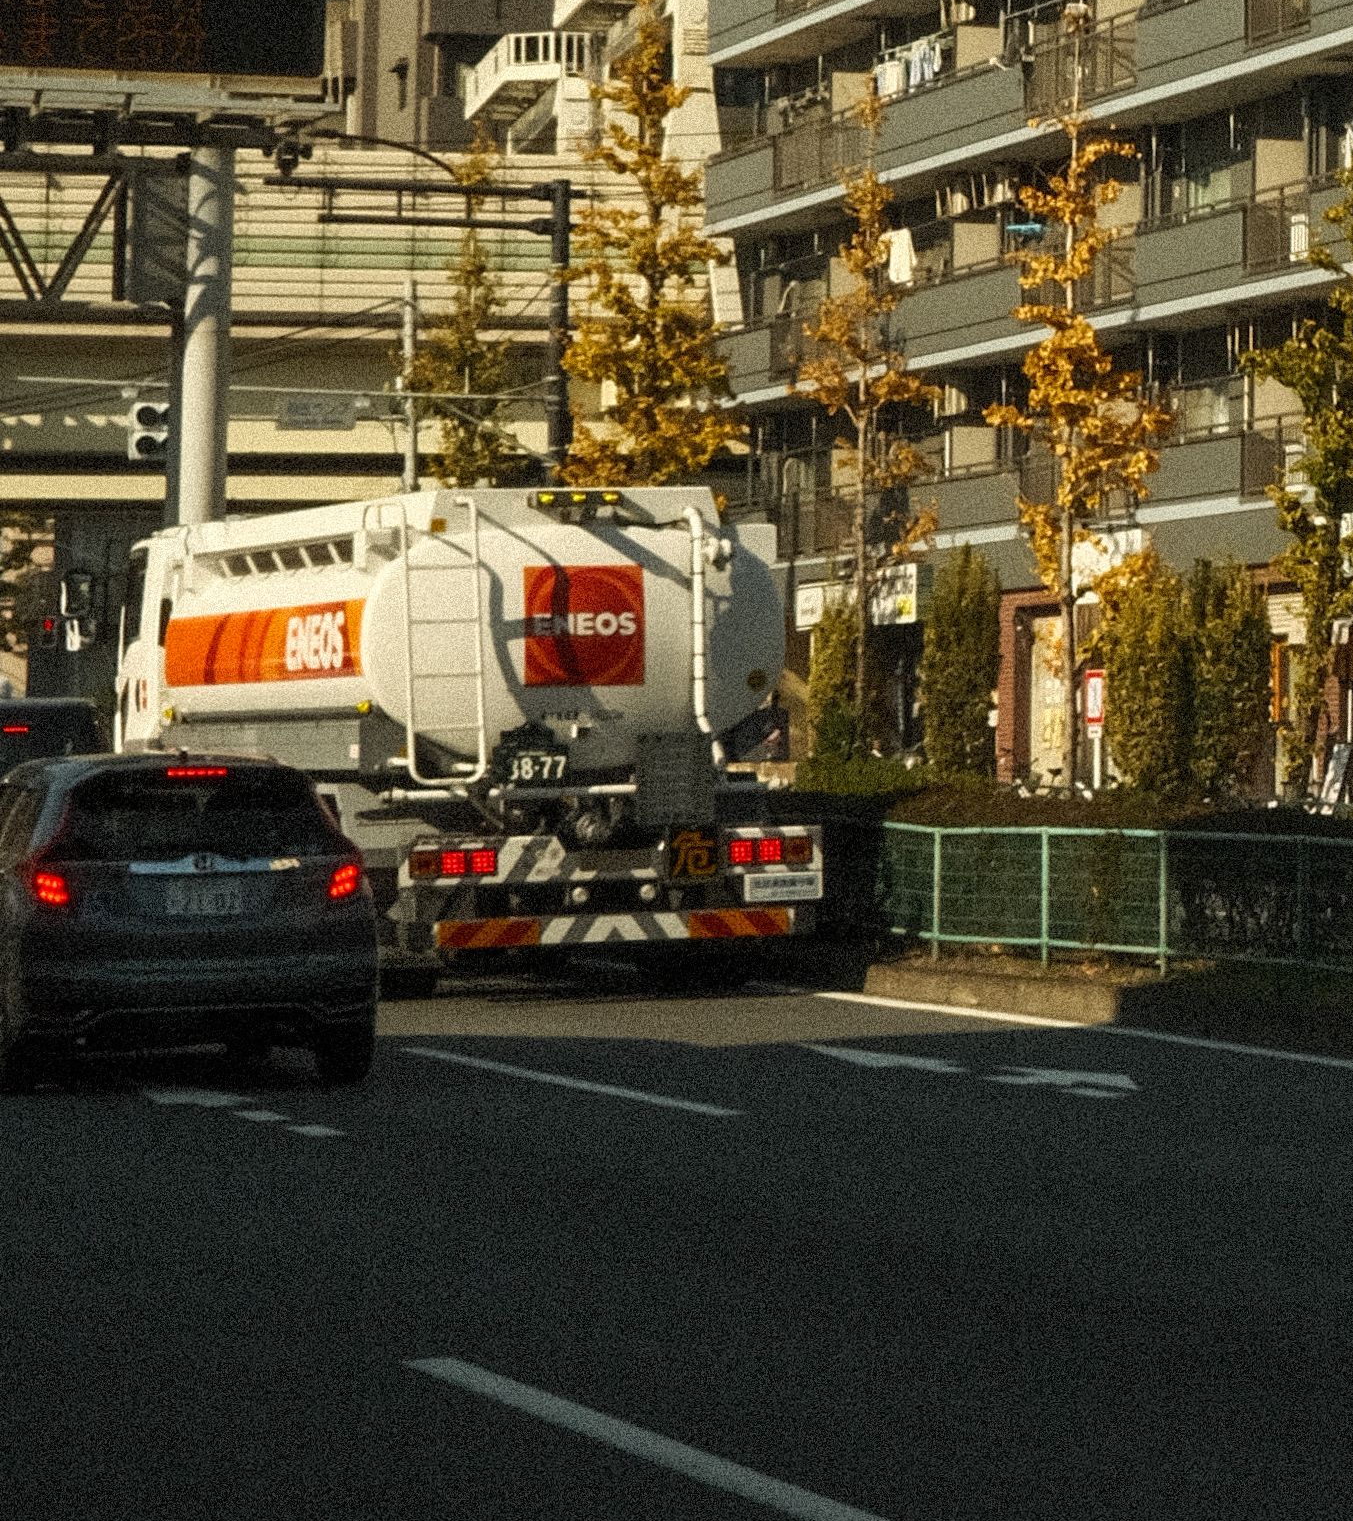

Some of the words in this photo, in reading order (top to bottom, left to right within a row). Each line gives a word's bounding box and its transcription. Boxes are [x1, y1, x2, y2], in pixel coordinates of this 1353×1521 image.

[284, 610, 346, 673] ENEOS
[533, 610, 637, 638] ENEOS
[671, 831, 717, 879] 危
